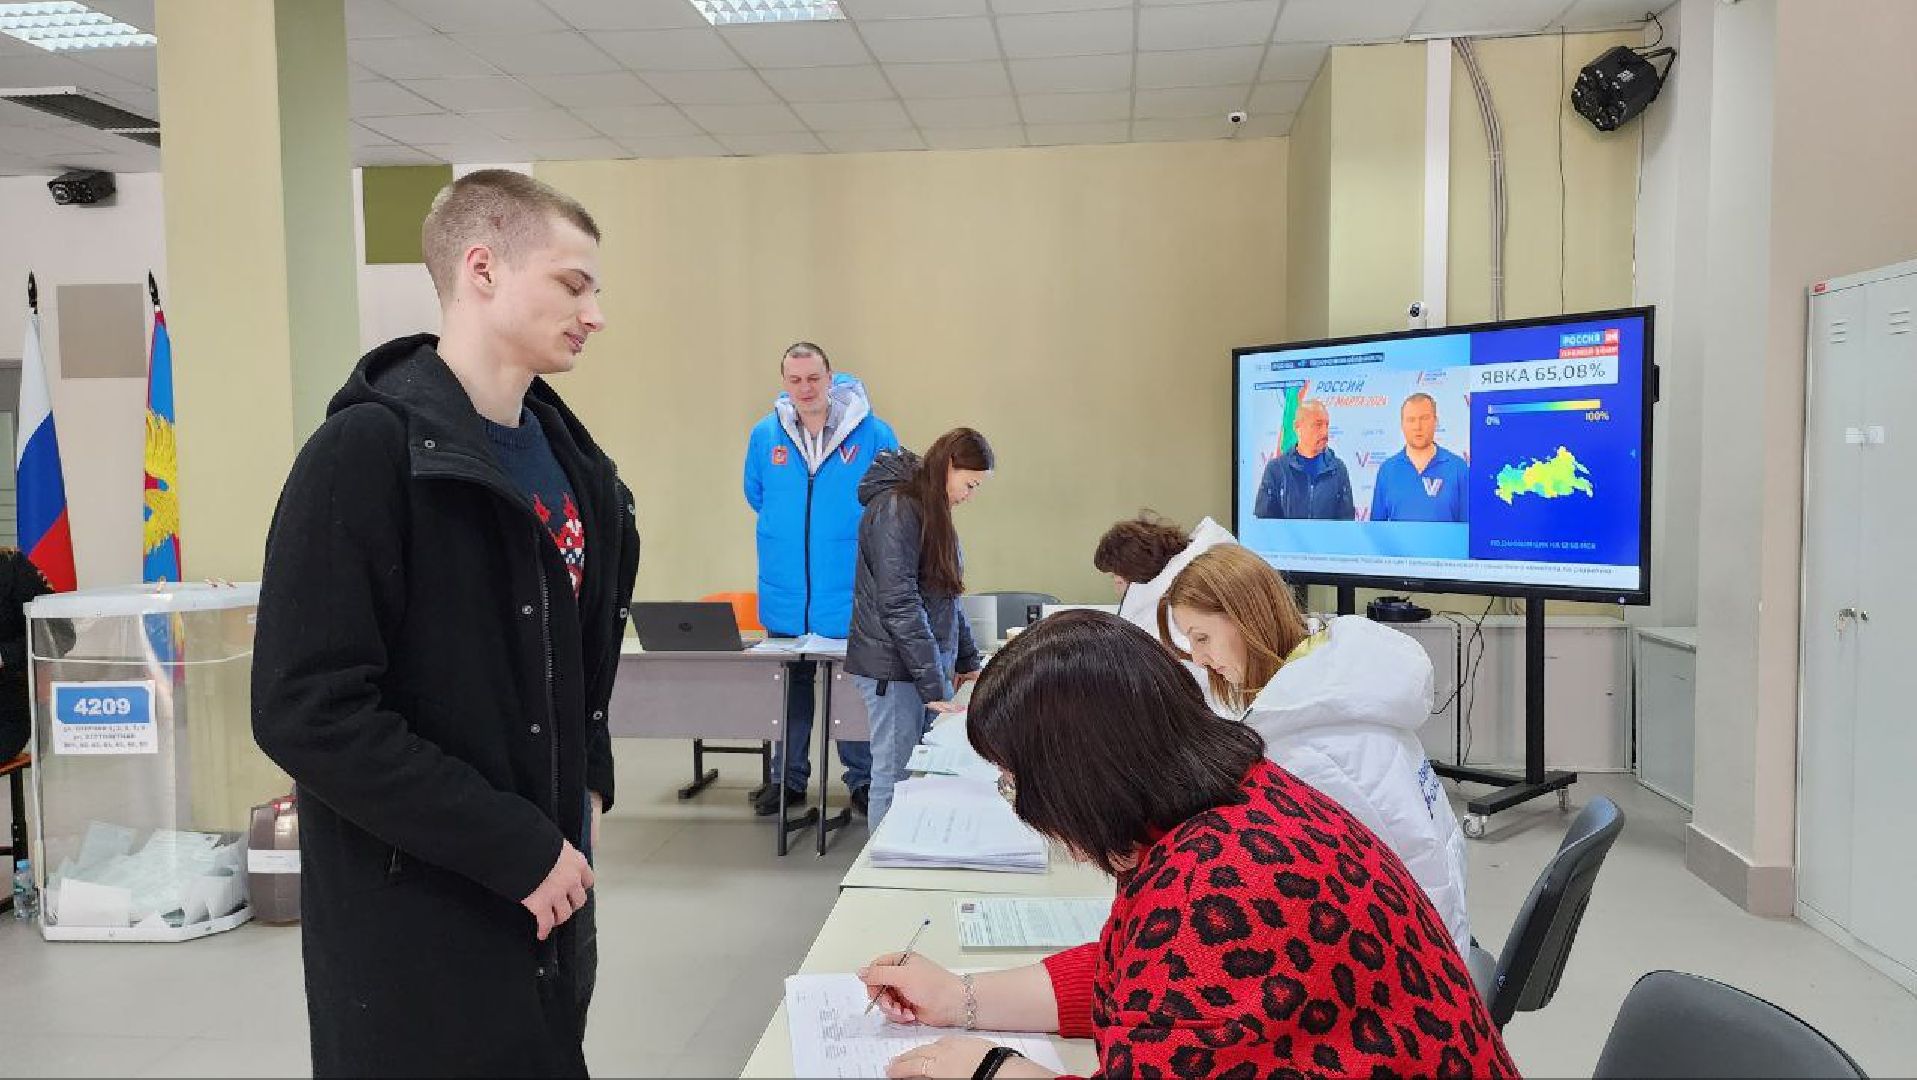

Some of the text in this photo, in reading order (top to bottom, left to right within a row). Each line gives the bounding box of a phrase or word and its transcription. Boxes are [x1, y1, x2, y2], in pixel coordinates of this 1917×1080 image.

[1481, 361, 1606, 385] ЯВКА 65,08%
[1585, 411, 1609, 421] 100%
[74, 697, 131, 715] 4209
